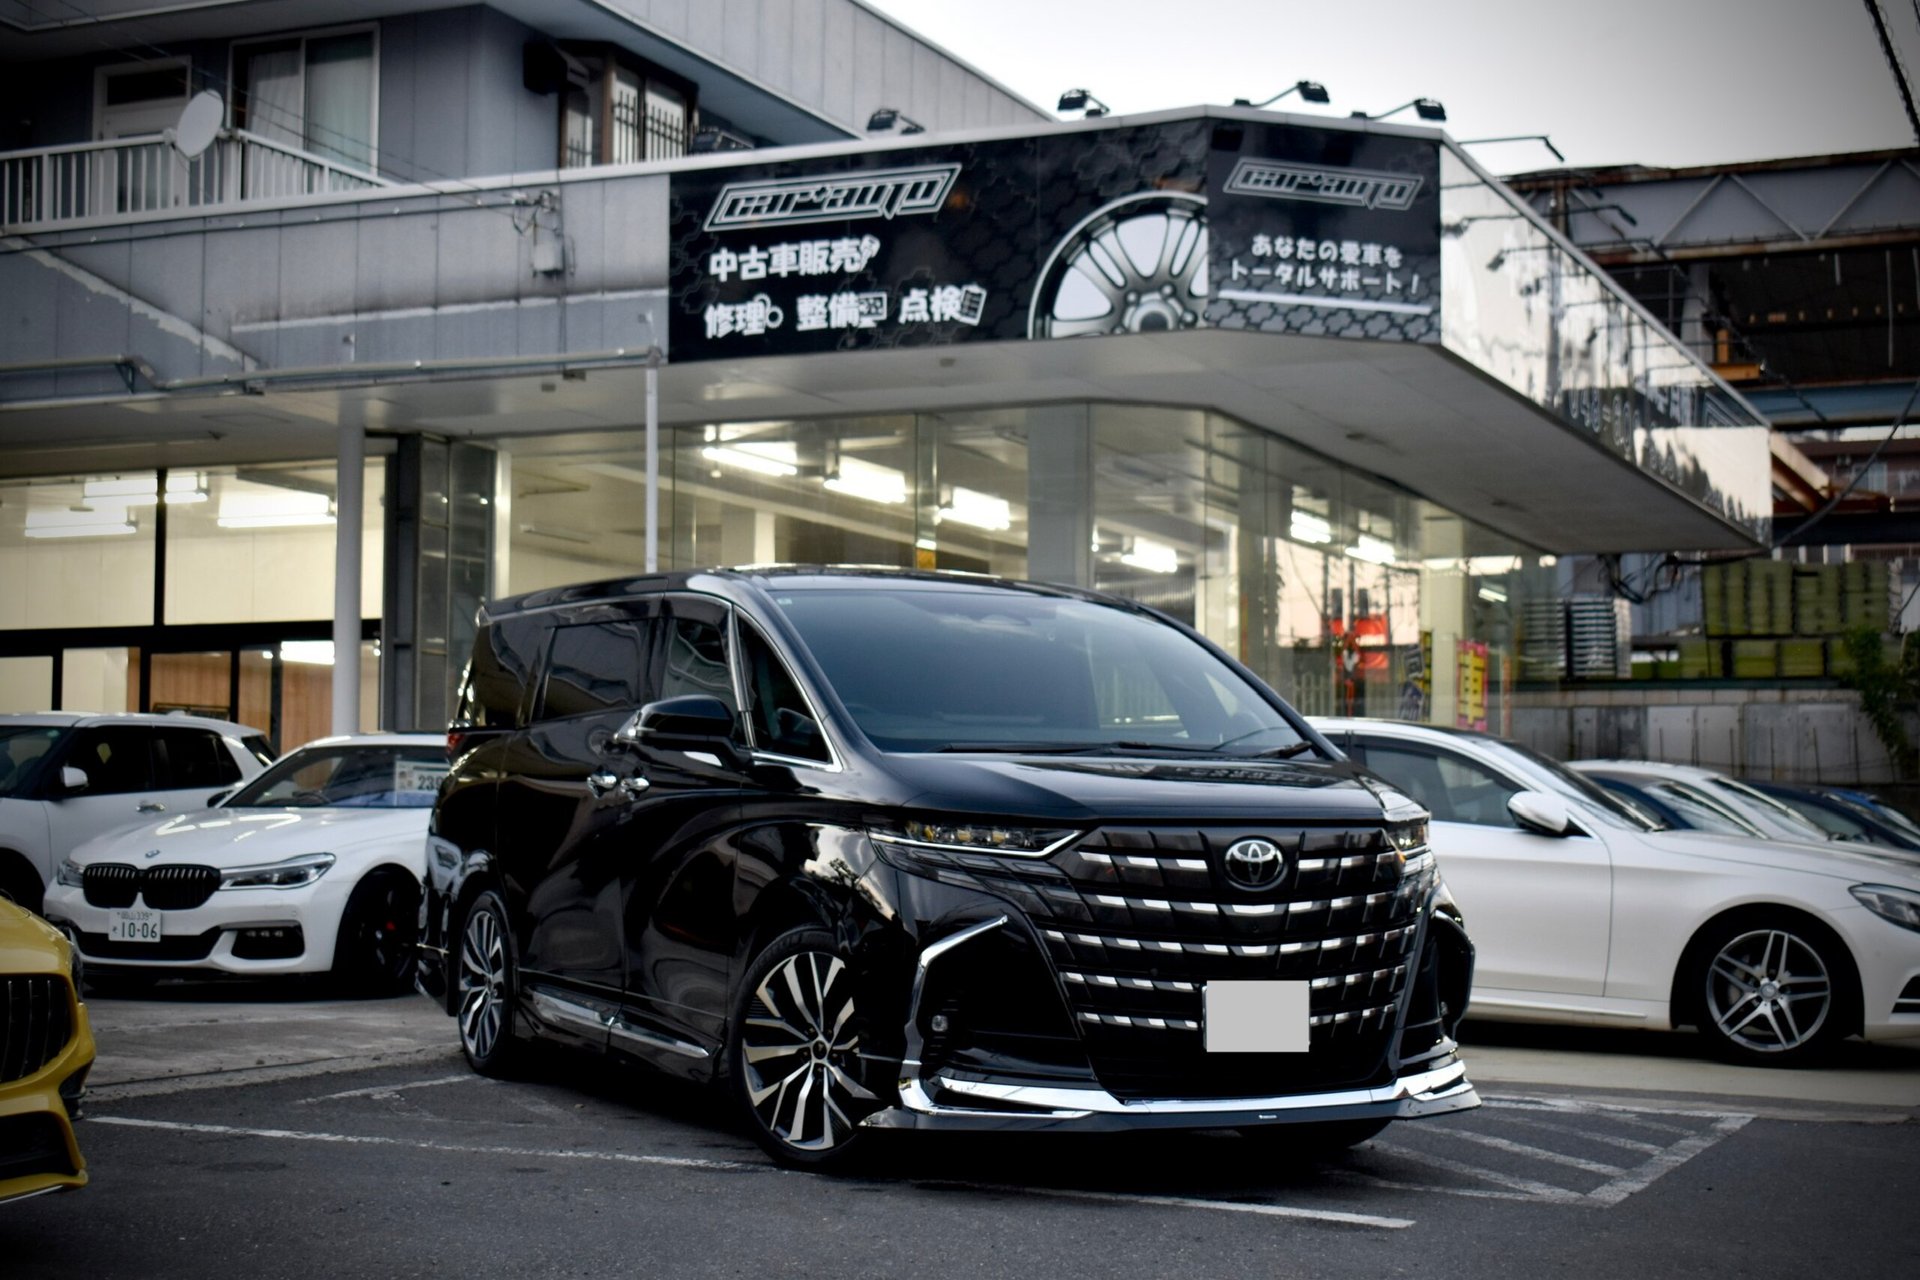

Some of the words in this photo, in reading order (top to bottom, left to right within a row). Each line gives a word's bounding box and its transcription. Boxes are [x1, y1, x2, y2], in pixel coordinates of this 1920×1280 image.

[709, 238, 862, 282] 中古車販売
[1252, 233, 1402, 268] あなたの愛車を
[704, 299, 766, 339] 修理
[796, 295, 860, 331] 整備
[899, 285, 962, 324] 点検
[121, 921, 158, 939] 10-06
